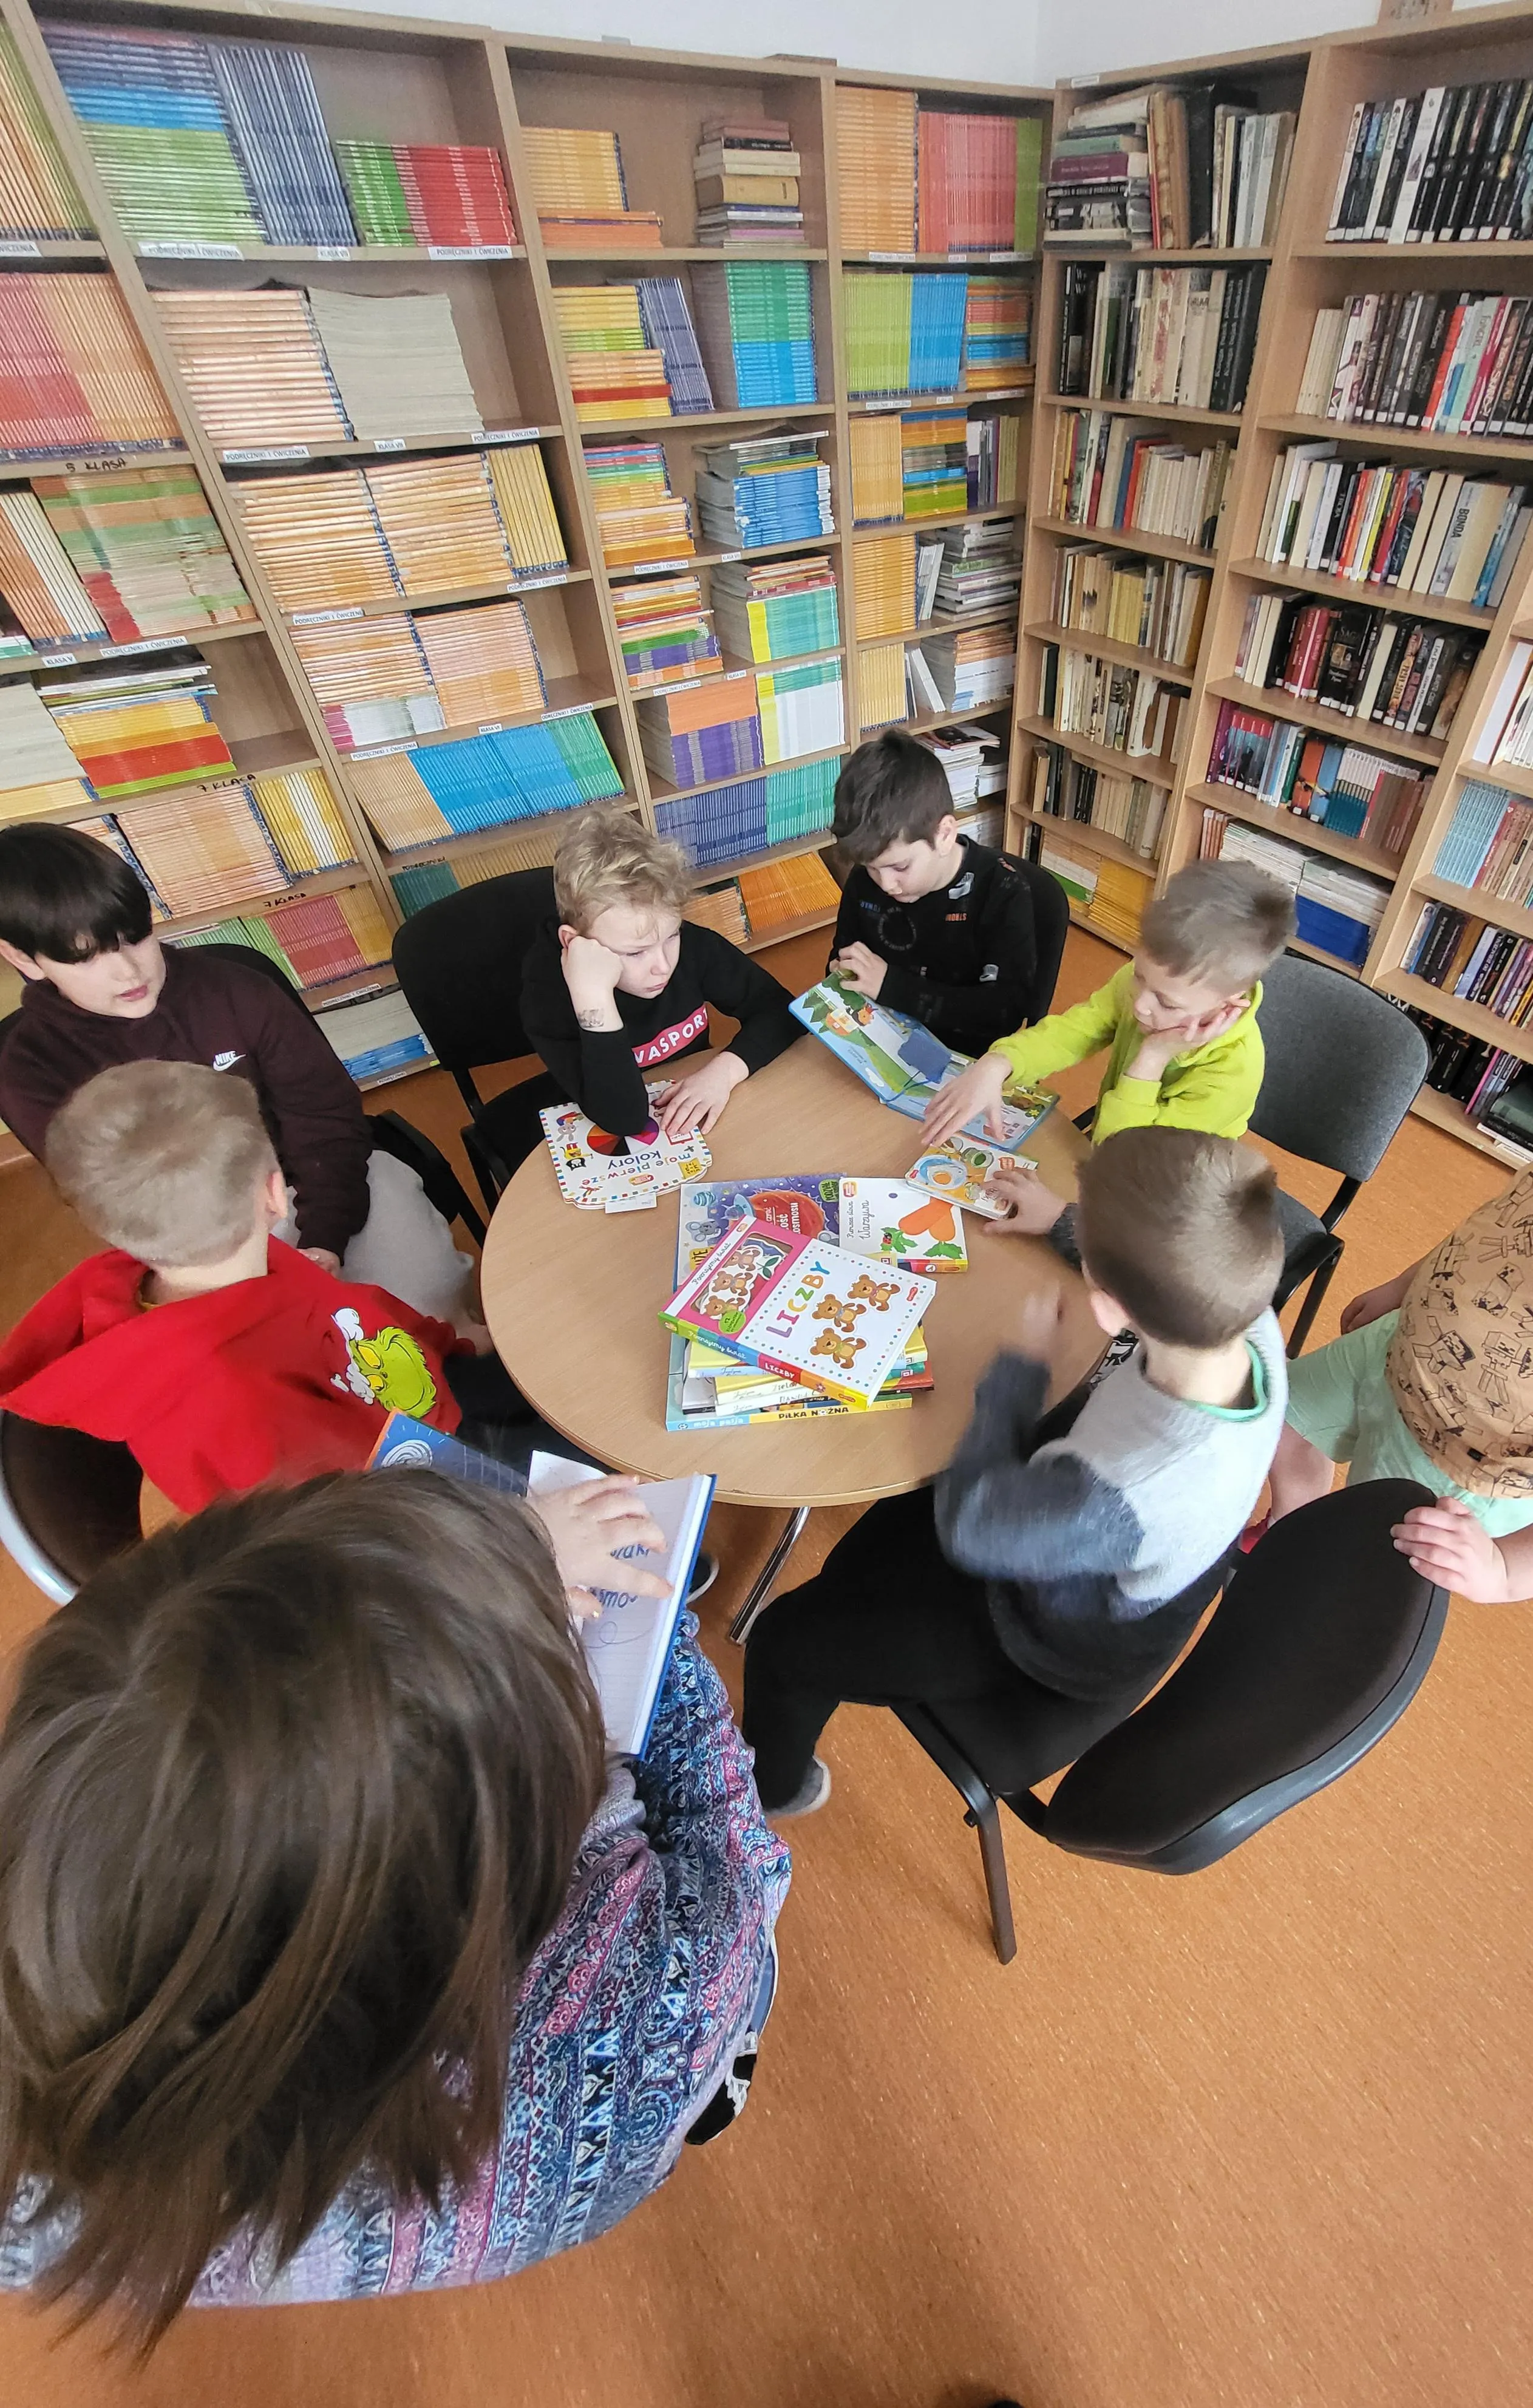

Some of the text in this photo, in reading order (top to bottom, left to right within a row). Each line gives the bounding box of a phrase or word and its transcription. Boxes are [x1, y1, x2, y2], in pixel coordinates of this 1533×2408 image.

[225, 451, 265, 461] PODRĘCZNIKI
[273, 449, 306, 458] ĆWICZENIA
[66, 457, 127, 472] 5 KLASA
[1450, 508, 1470, 539] BONDA
[294, 615, 330, 625] PODRĘCZNIKI
[101, 645, 144, 656] PODRĘCZNIKI
[150, 638, 185, 648] ĆWICZENIA
[46, 657, 66, 665] KLASA
[570, 704, 593, 713] ĆWICZENIA
[352, 749, 385, 759] PODRĘCZNIKI
[390, 743, 417, 752] ĆWICZENIA
[274, 893, 307, 906] KLASA
[215, 1050, 237, 1065] NIKE
[608, 1150, 662, 1170] kolory
[656, 1153, 692, 1167] moje
[776, 1213, 789, 1231] ość
[789, 1202, 802, 1235] osmosu
[857, 1199, 875, 1240] Warzywa
[692, 1256, 721, 1285] Poznajemy
[766, 1260, 831, 1338] LICZBY
[688, 1330, 726, 1353] Poznajemy
[764, 1362, 795, 1379] LICZBY
[693, 1419, 716, 1428] moja
